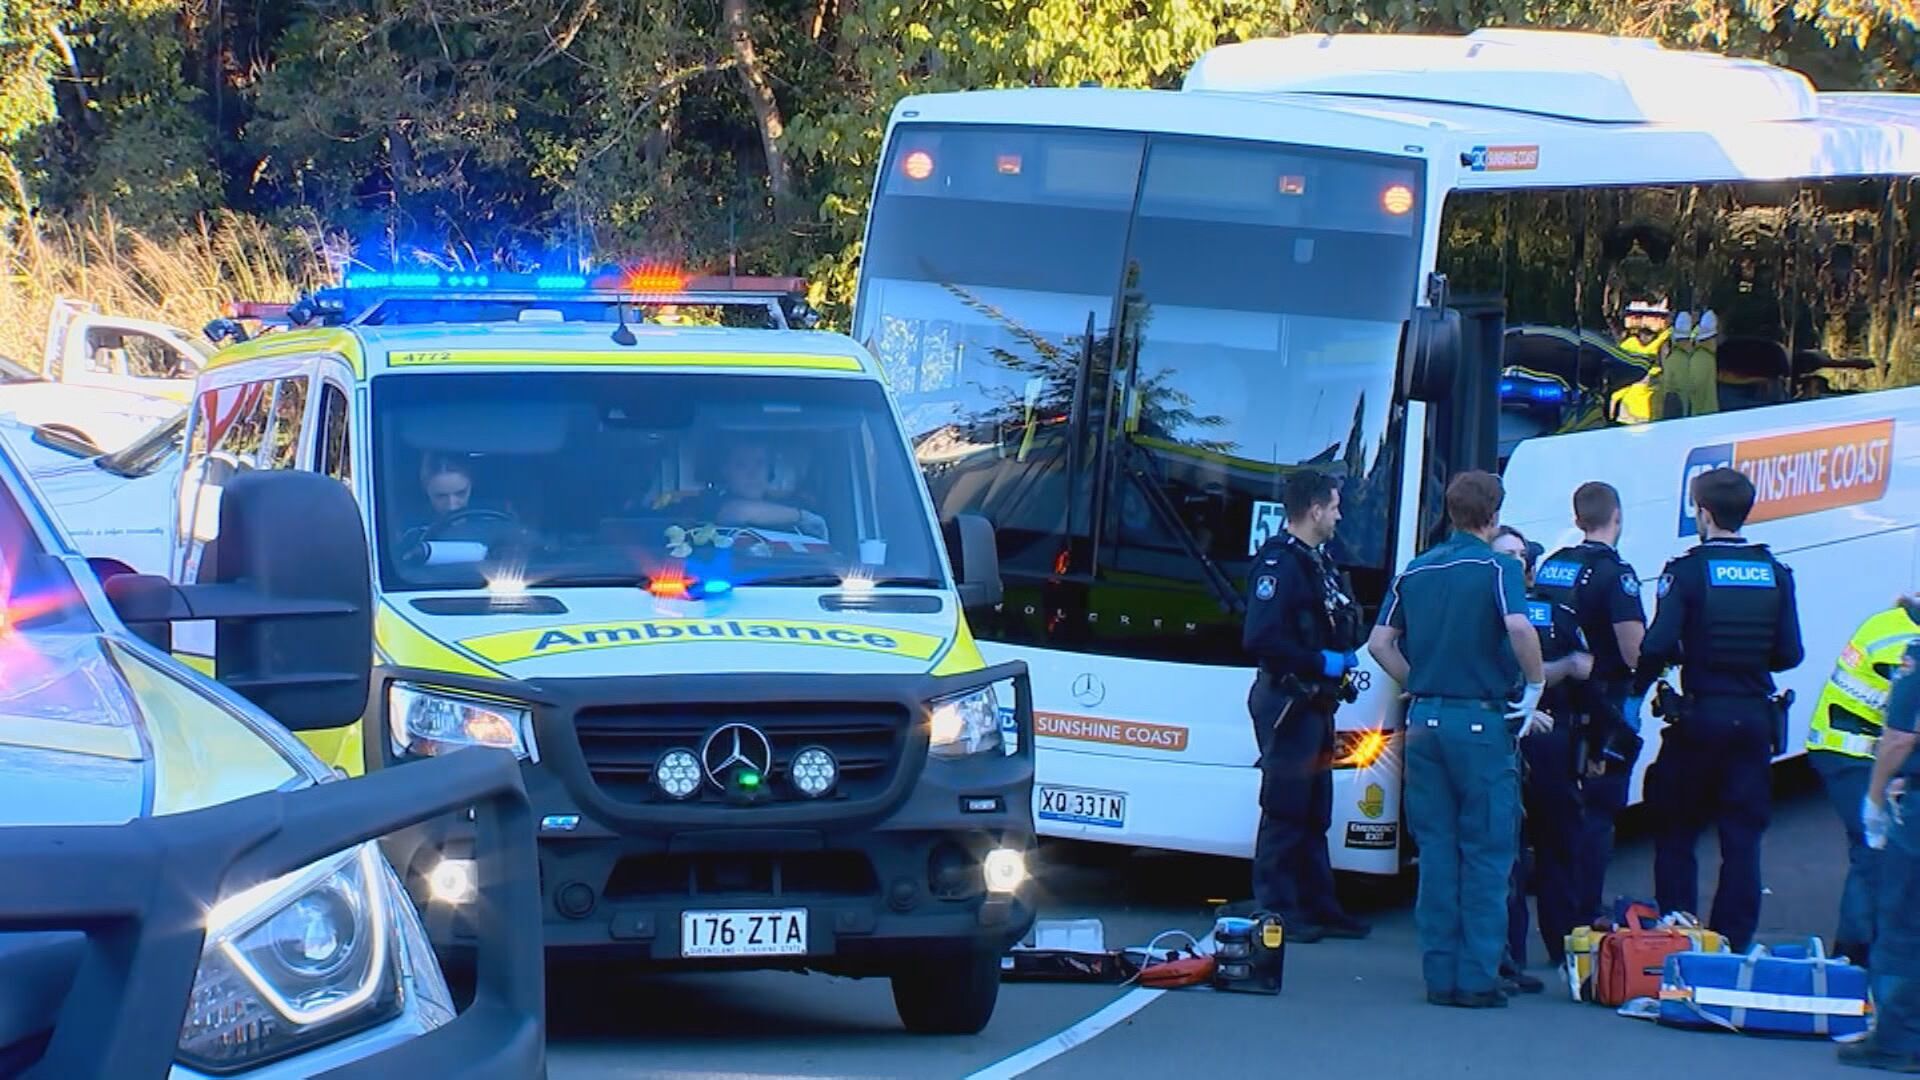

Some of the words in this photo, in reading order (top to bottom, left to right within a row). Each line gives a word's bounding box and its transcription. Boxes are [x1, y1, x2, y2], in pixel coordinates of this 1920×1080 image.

[1831, 439, 1889, 489] COAST
[1541, 565, 1577, 580] POLICE
[1716, 567, 1770, 581] POLICE
[534, 621, 898, 650] Ambulance
[1038, 717, 1121, 740] SUNSHINE
[1125, 727, 1183, 746] COAST
[1043, 791, 1066, 812] XQ
